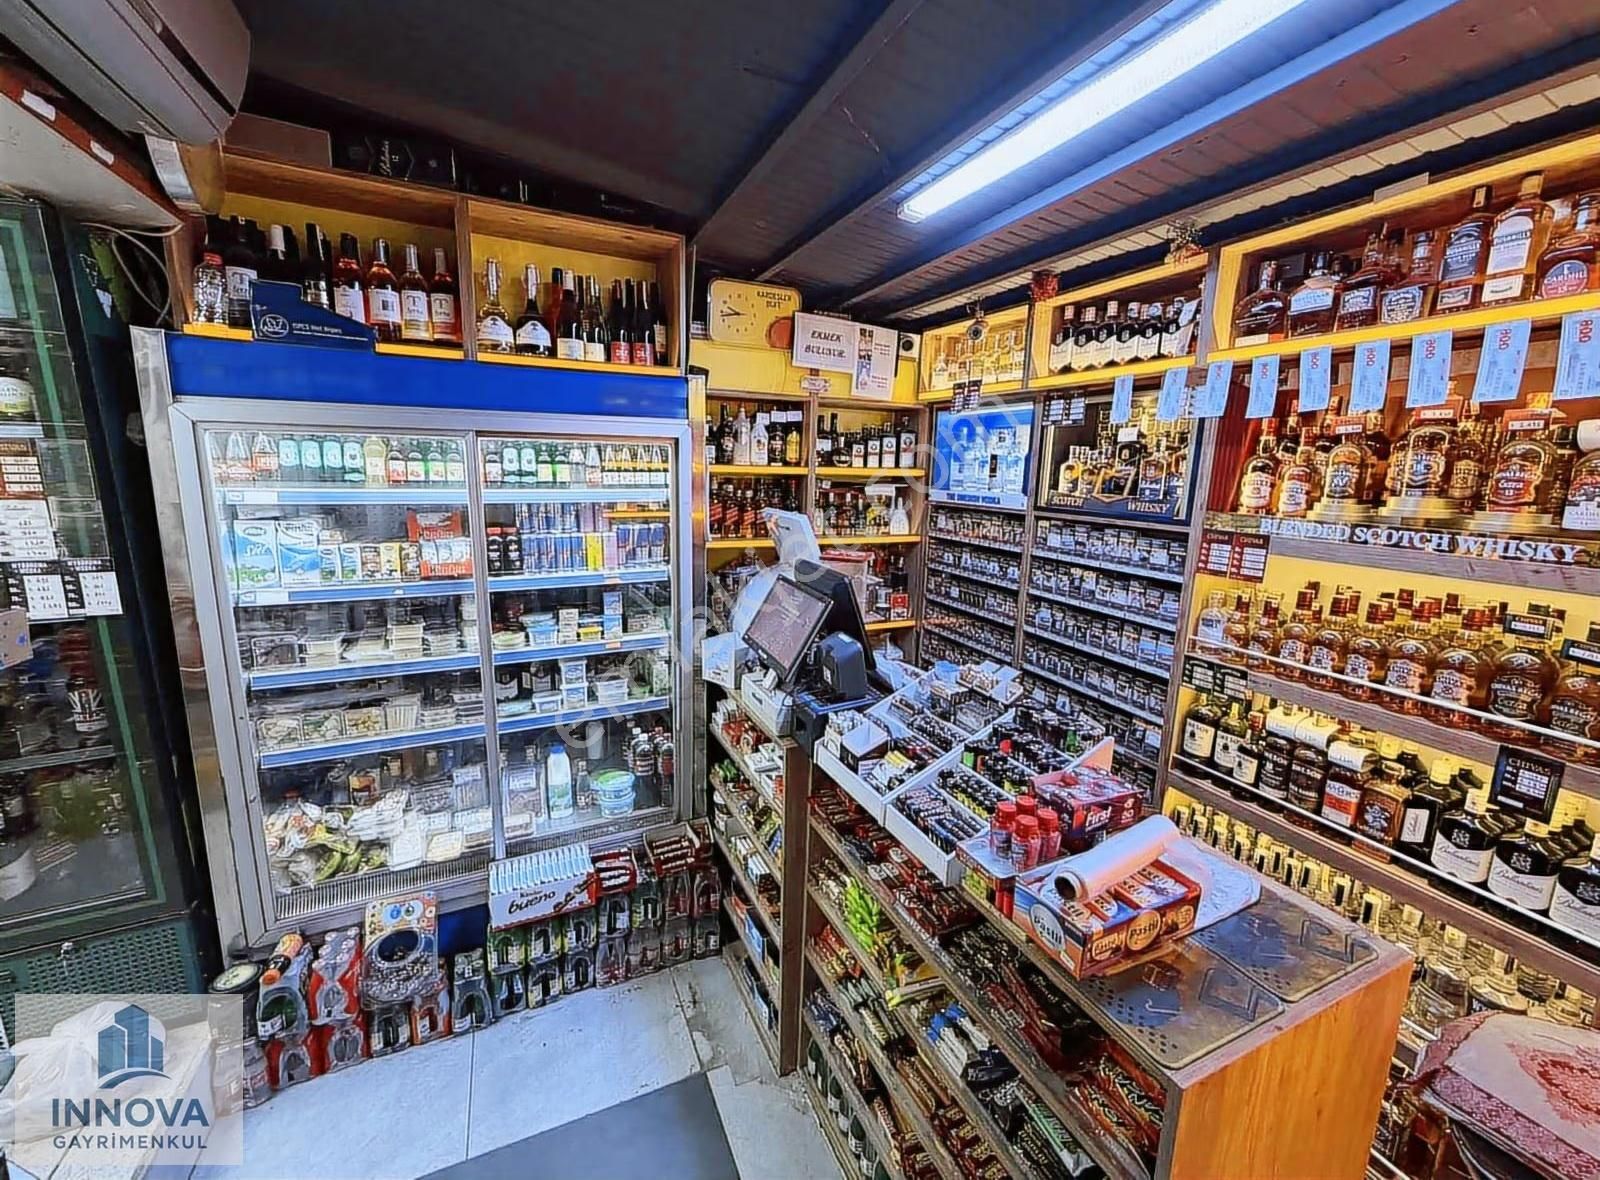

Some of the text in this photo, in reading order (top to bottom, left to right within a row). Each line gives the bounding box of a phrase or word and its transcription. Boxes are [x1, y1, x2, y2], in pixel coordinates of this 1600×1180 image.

[1050, 495, 1169, 514] SCOTCH WHISKY
[1259, 517, 1586, 562] BLENDED SCOTCH WHISKY
[1085, 805, 1112, 827] First
[508, 890, 556, 915] bueno
